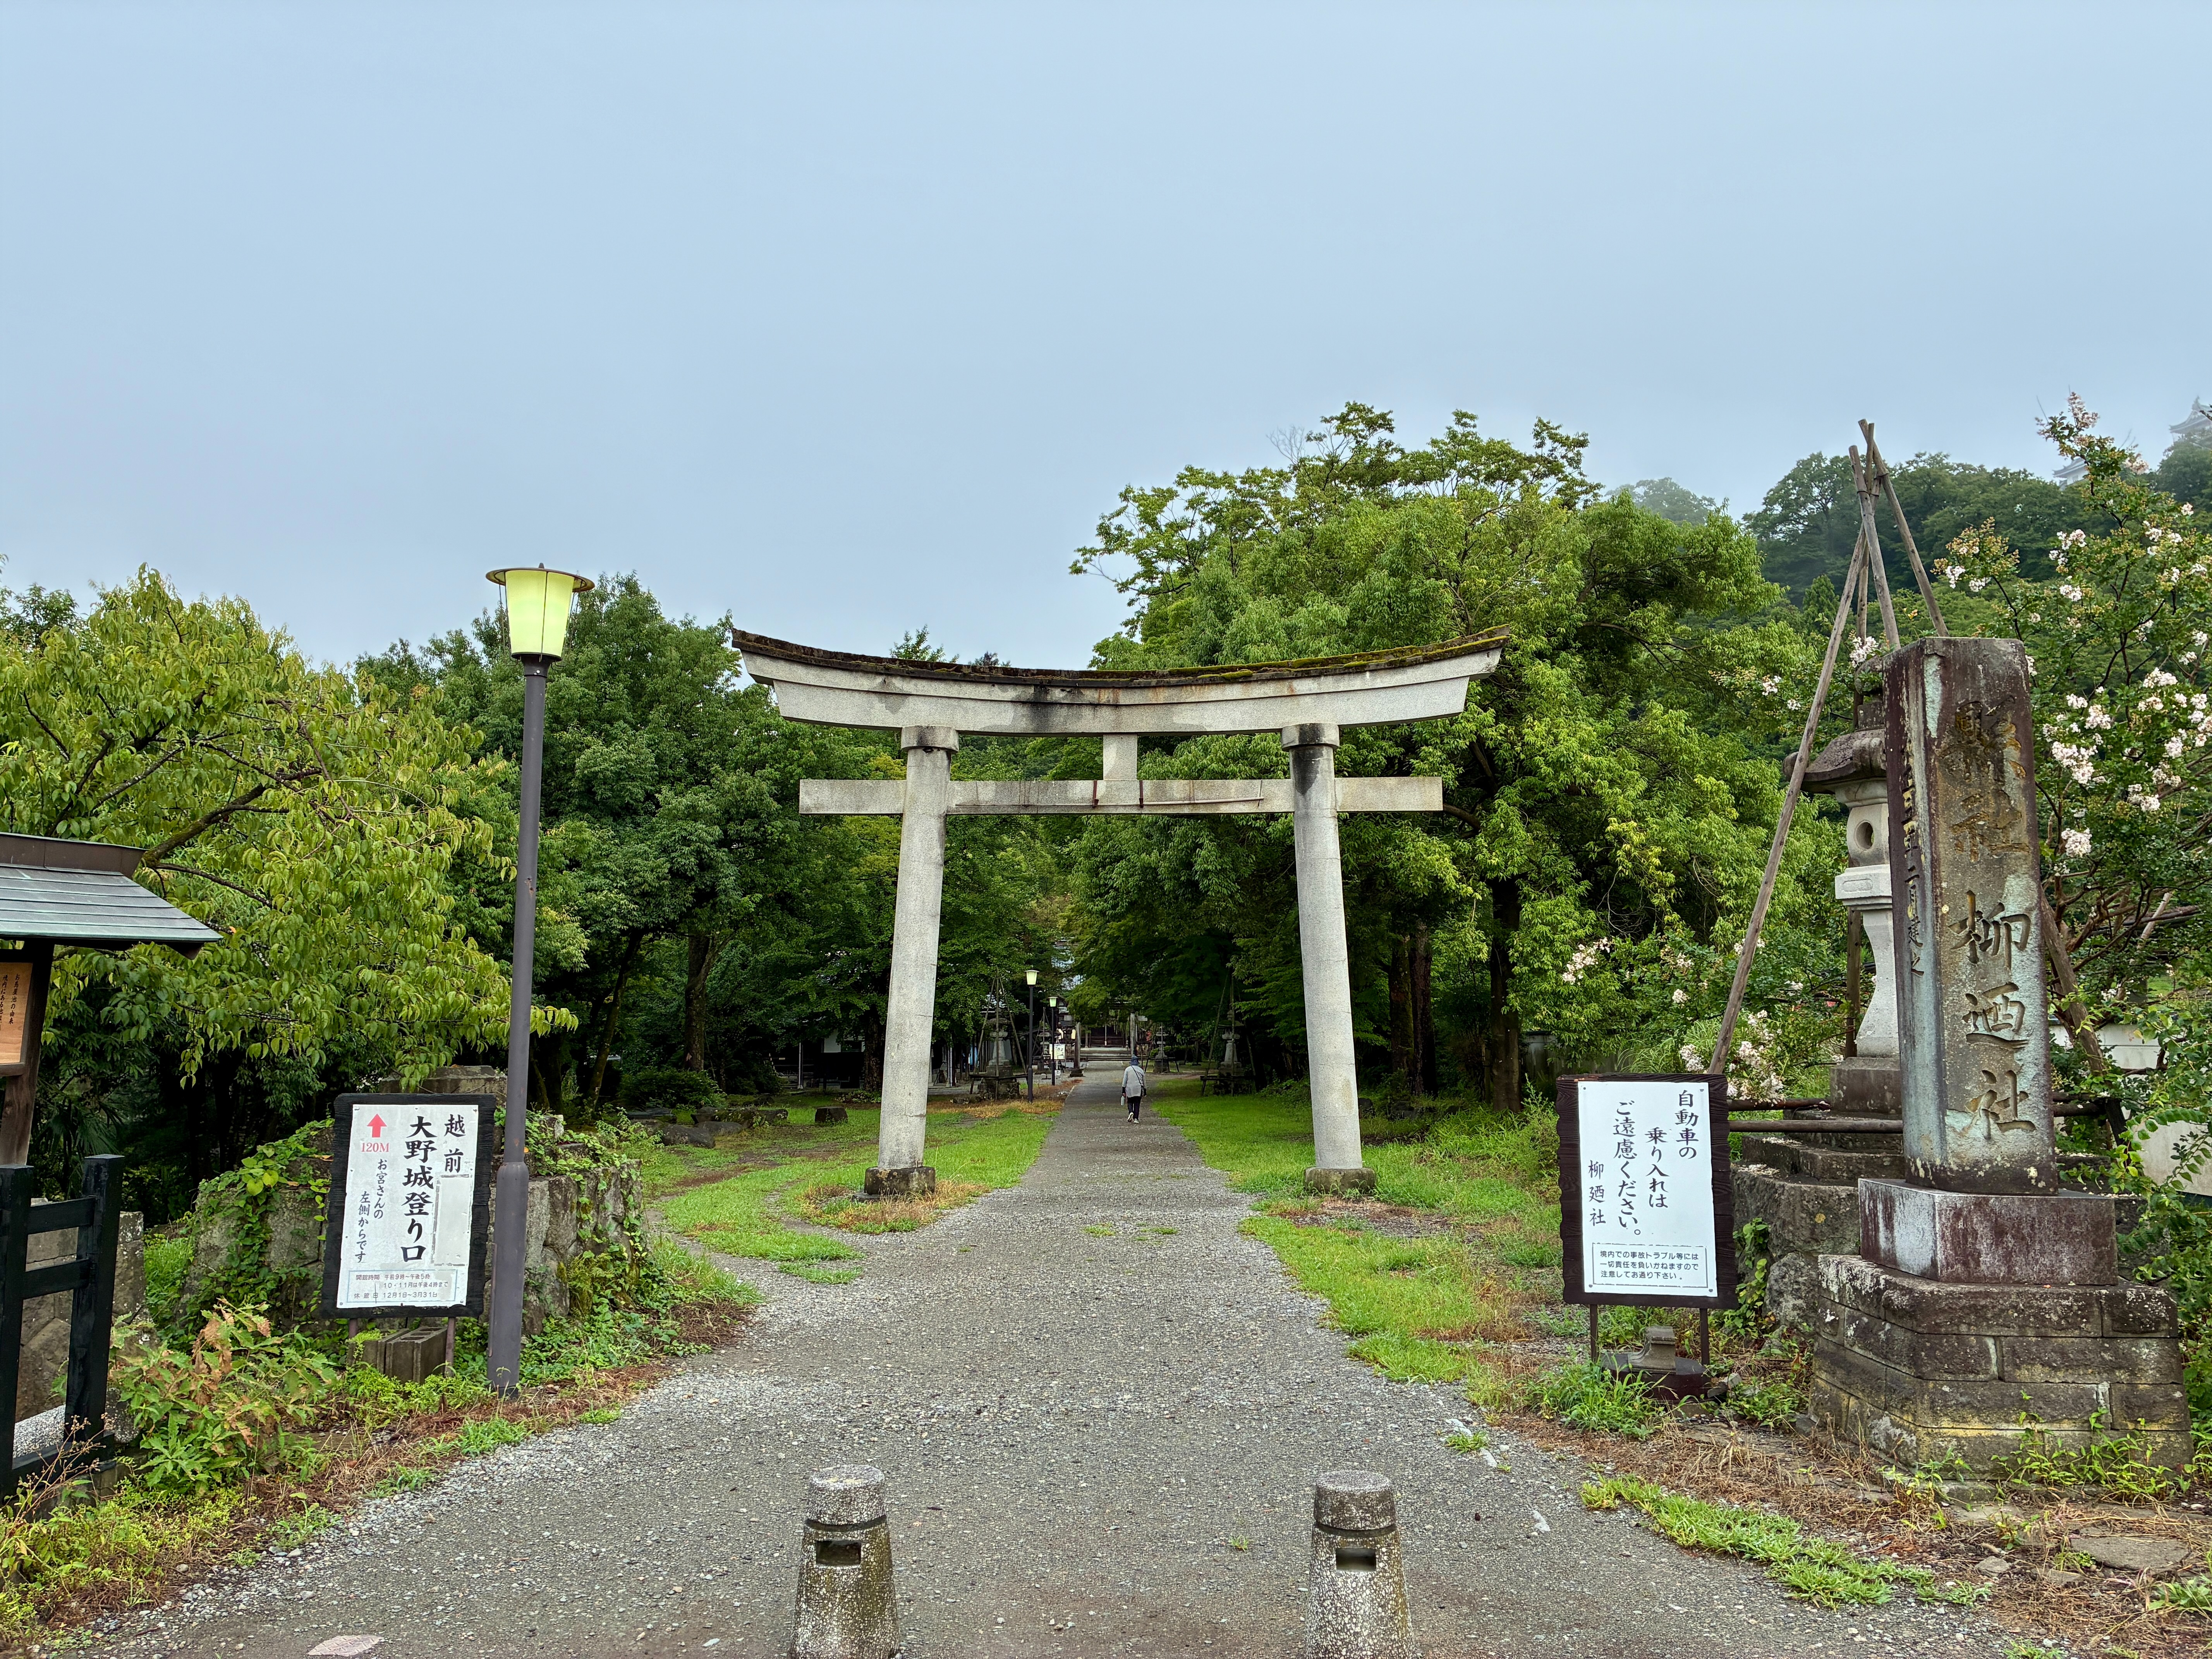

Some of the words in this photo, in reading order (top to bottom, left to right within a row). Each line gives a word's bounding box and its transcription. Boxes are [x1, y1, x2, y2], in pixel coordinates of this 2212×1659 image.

[361, 1142, 389, 1152] 120M
[444, 1114, 466, 1173] 越前
[1674, 1090, 1699, 1159] 自動車の
[374, 1159, 388, 1219] お宮さんの
[400, 1116, 438, 1262] 大野城登り口
[1613, 1100, 1641, 1235] ご遠慮ください。
[1645, 1127, 1671, 1208] 乗り入れは
[355, 1191, 371, 1263] 左側からです
[1600, 1250, 1699, 1260] 境内での事故トラブル等には
[1600, 1261, 1699, 1270] 一切責任を負いかねますので
[1601, 1270, 1682, 1280] 注意してお通り下さい。
